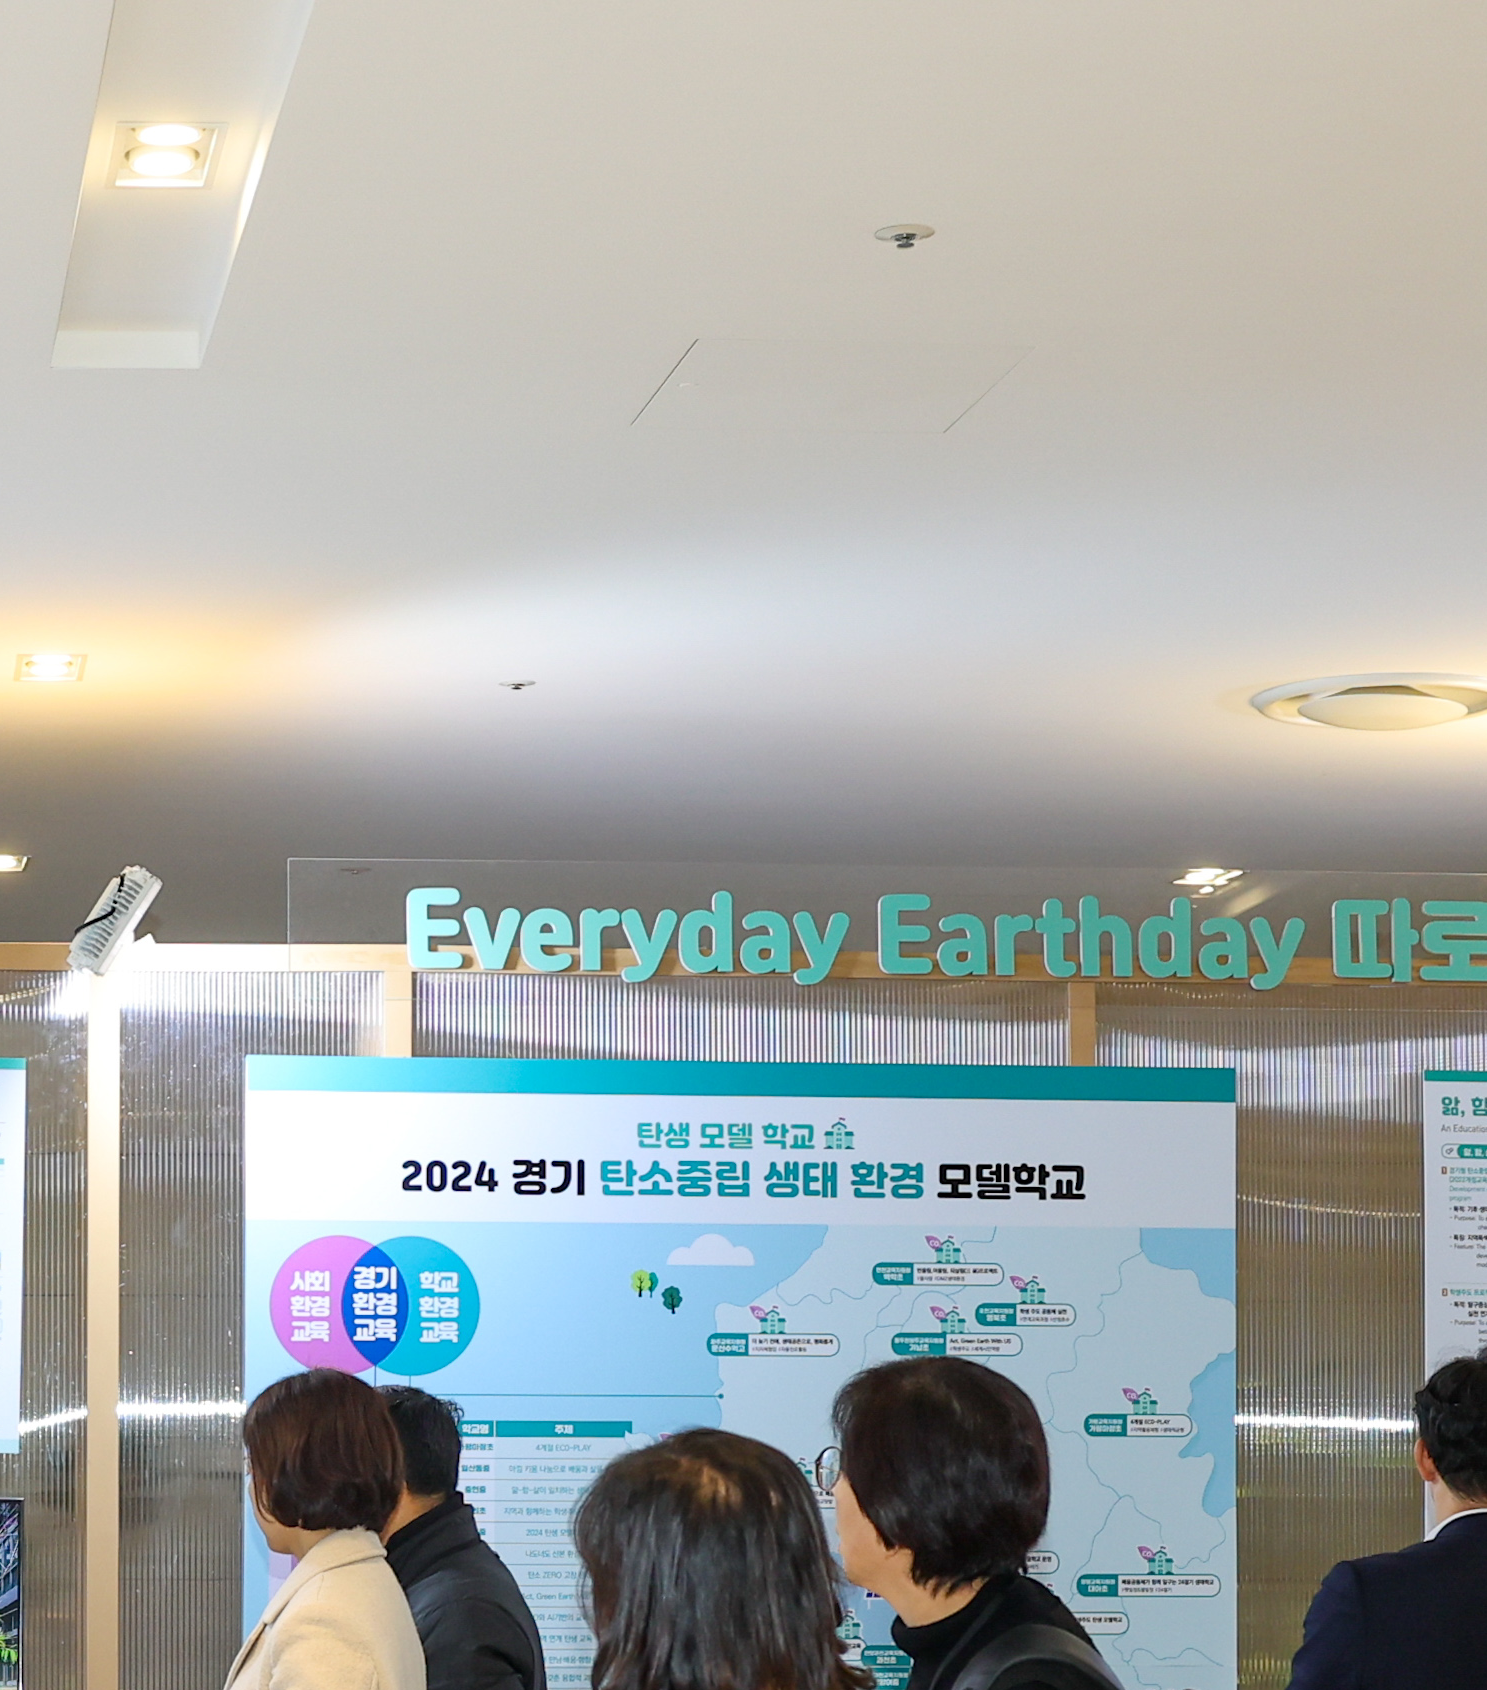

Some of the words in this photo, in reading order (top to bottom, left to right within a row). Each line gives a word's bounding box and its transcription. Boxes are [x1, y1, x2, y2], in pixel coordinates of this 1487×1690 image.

[406, 887, 850, 985] Everyday
[878, 893, 1305, 990] Earthday
[1441, 1097, 1465, 1118] 앎,
[638, 1123, 691, 1149] 탄생
[699, 1123, 754, 1149] 모델
[762, 1123, 815, 1150] 학교
[1441, 1125, 1452, 1133] An
[401, 1160, 498, 1193] 2024
[512, 1159, 586, 1196] 경기
[600, 1159, 750, 1198] 탄소중립
[764, 1161, 838, 1199] 생태
[850, 1161, 924, 1199] 환경
[938, 1162, 1086, 1201] 모델학교
[290, 1270, 330, 1292] 사회
[353, 1266, 397, 1290] 경기
[419, 1271, 459, 1293] 학교
[290, 1296, 330, 1317] 환경
[352, 1292, 398, 1316] 환경
[419, 1296, 460, 1318] 환경
[290, 1320, 330, 1342] 교육
[353, 1318, 397, 1342] 교육
[419, 1321, 459, 1343] 교육
[555, 1424, 574, 1435] 주제
